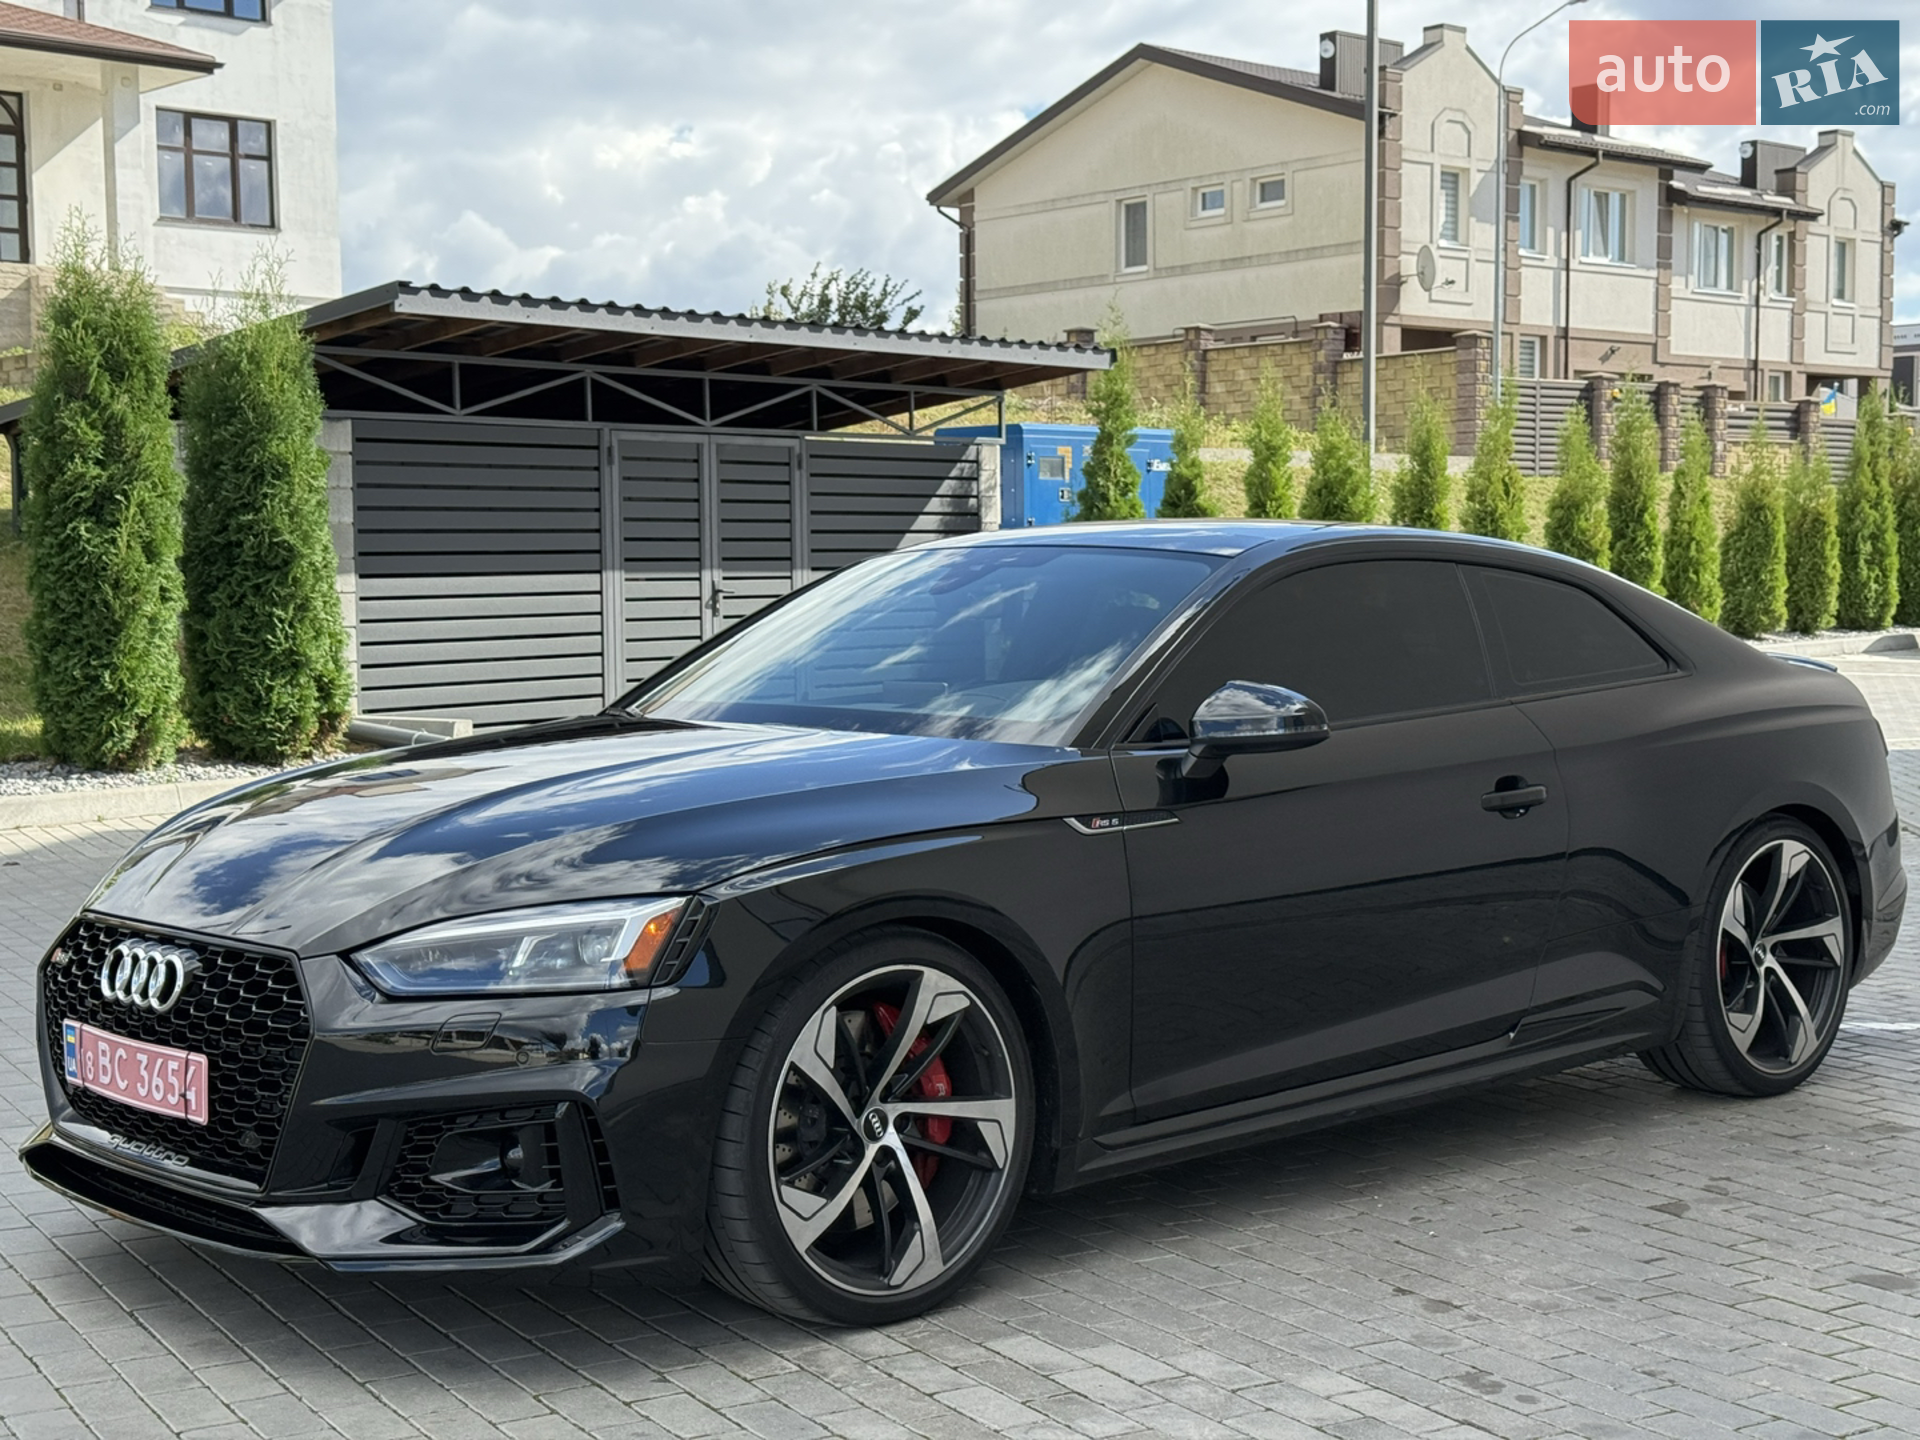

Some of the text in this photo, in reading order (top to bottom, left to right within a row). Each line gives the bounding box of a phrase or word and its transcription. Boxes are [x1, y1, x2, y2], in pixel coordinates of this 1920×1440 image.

[98, 1041, 128, 1090] BC
[136, 1052, 197, 1111] 3654
[108, 1134, 190, 1166] quattro
